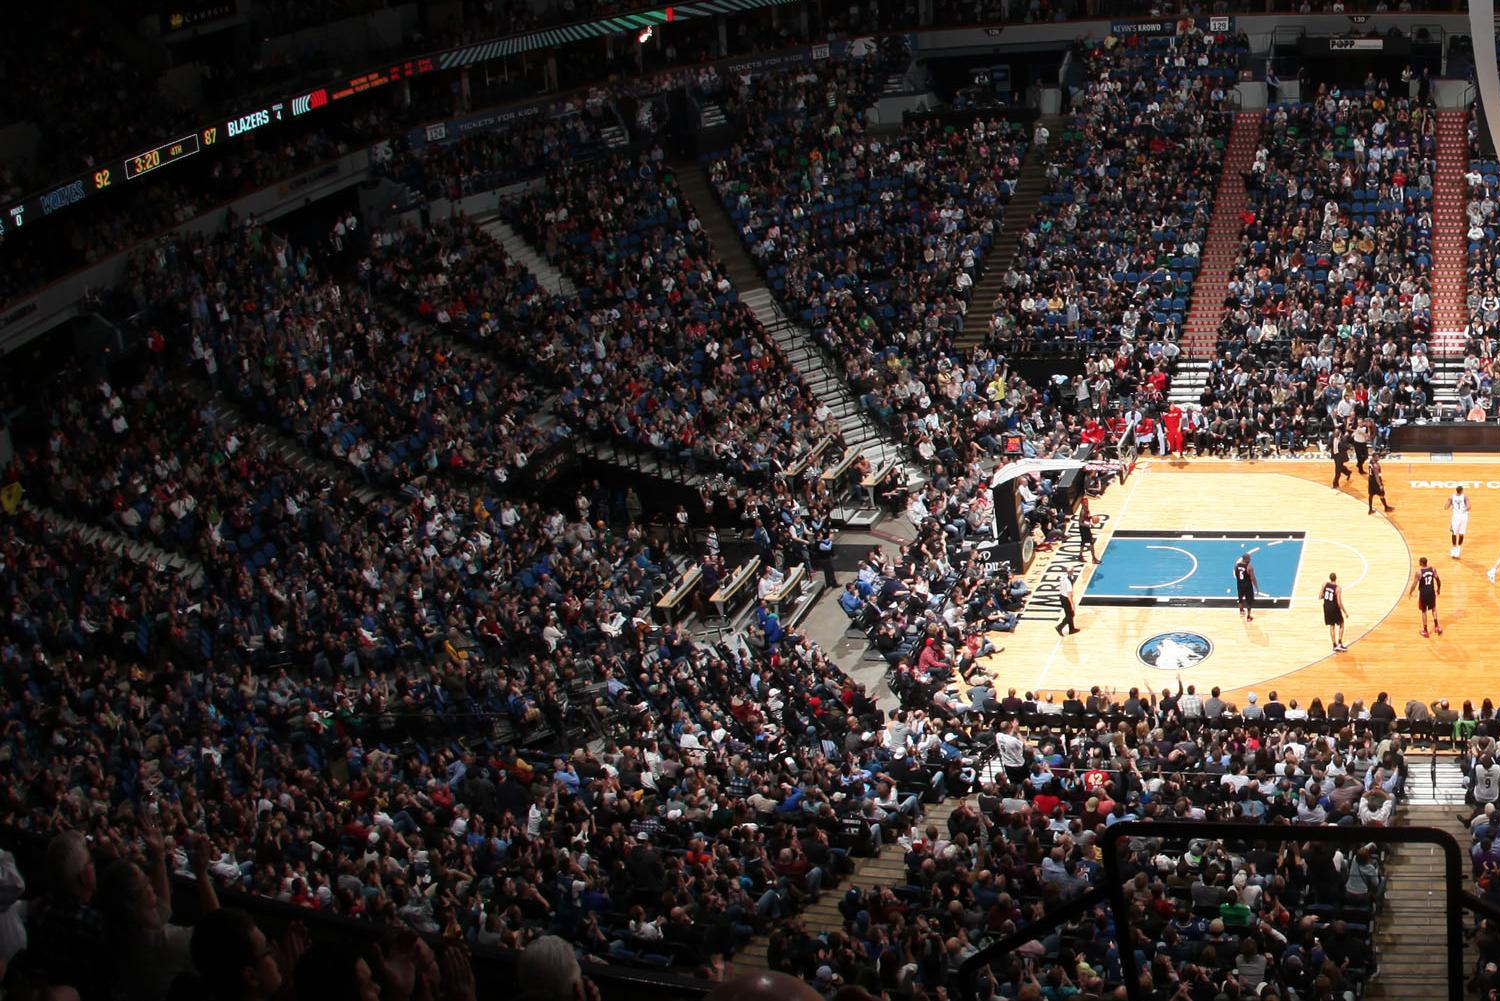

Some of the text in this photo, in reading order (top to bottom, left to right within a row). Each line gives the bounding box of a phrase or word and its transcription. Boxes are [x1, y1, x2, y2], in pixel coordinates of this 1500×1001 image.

[1138, 23, 1161, 32] KROWD
[1213, 22, 1226, 31] 129
[728, 61, 761, 73] TICKETS
[227, 110, 282, 137] BLAZERS 4
[203, 127, 217, 145] 87
[134, 151, 160, 173] 3:20
[95, 170, 111, 189] 92
[40, 180, 86, 215] WOLVES
[1408, 480, 1482, 489] TARGET
[1239, 570, 1244, 580] 5
[1424, 576, 1432, 585] 12
[1324, 591, 1334, 601] 88
[1088, 773, 1103, 785] 42
[1484, 778, 1491, 789] 9
